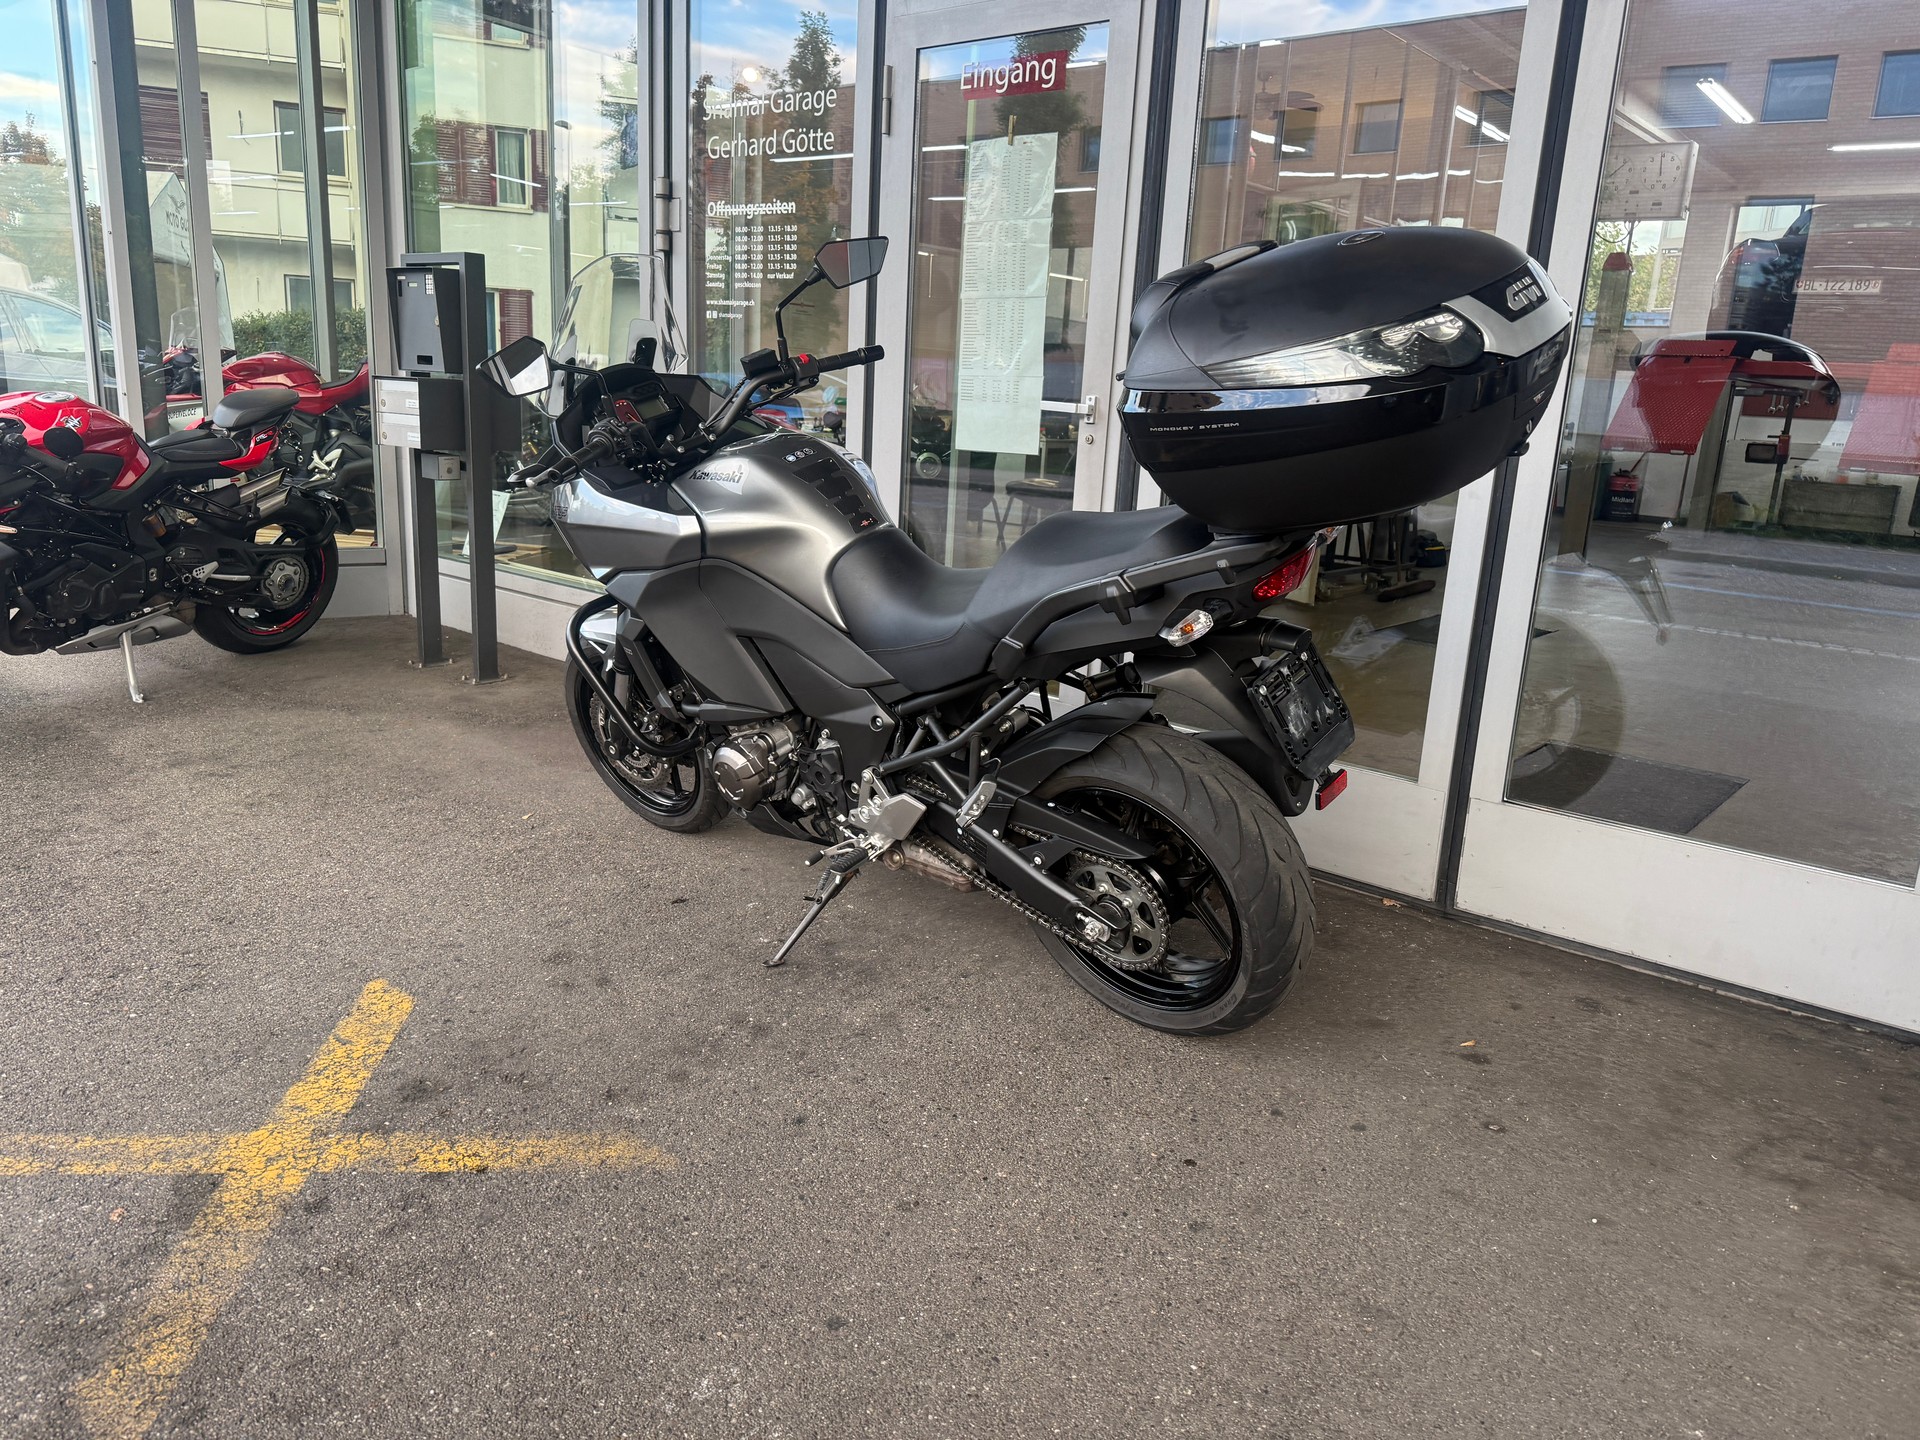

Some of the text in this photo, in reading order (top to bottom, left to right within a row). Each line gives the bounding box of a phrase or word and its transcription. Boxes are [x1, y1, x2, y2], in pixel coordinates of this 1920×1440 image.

[961, 58, 1057, 94] Eingang
[770, 88, 838, 117] Garage
[707, 127, 835, 159] Gerhard Götte
[688, 468, 744, 484] Kawasaki
